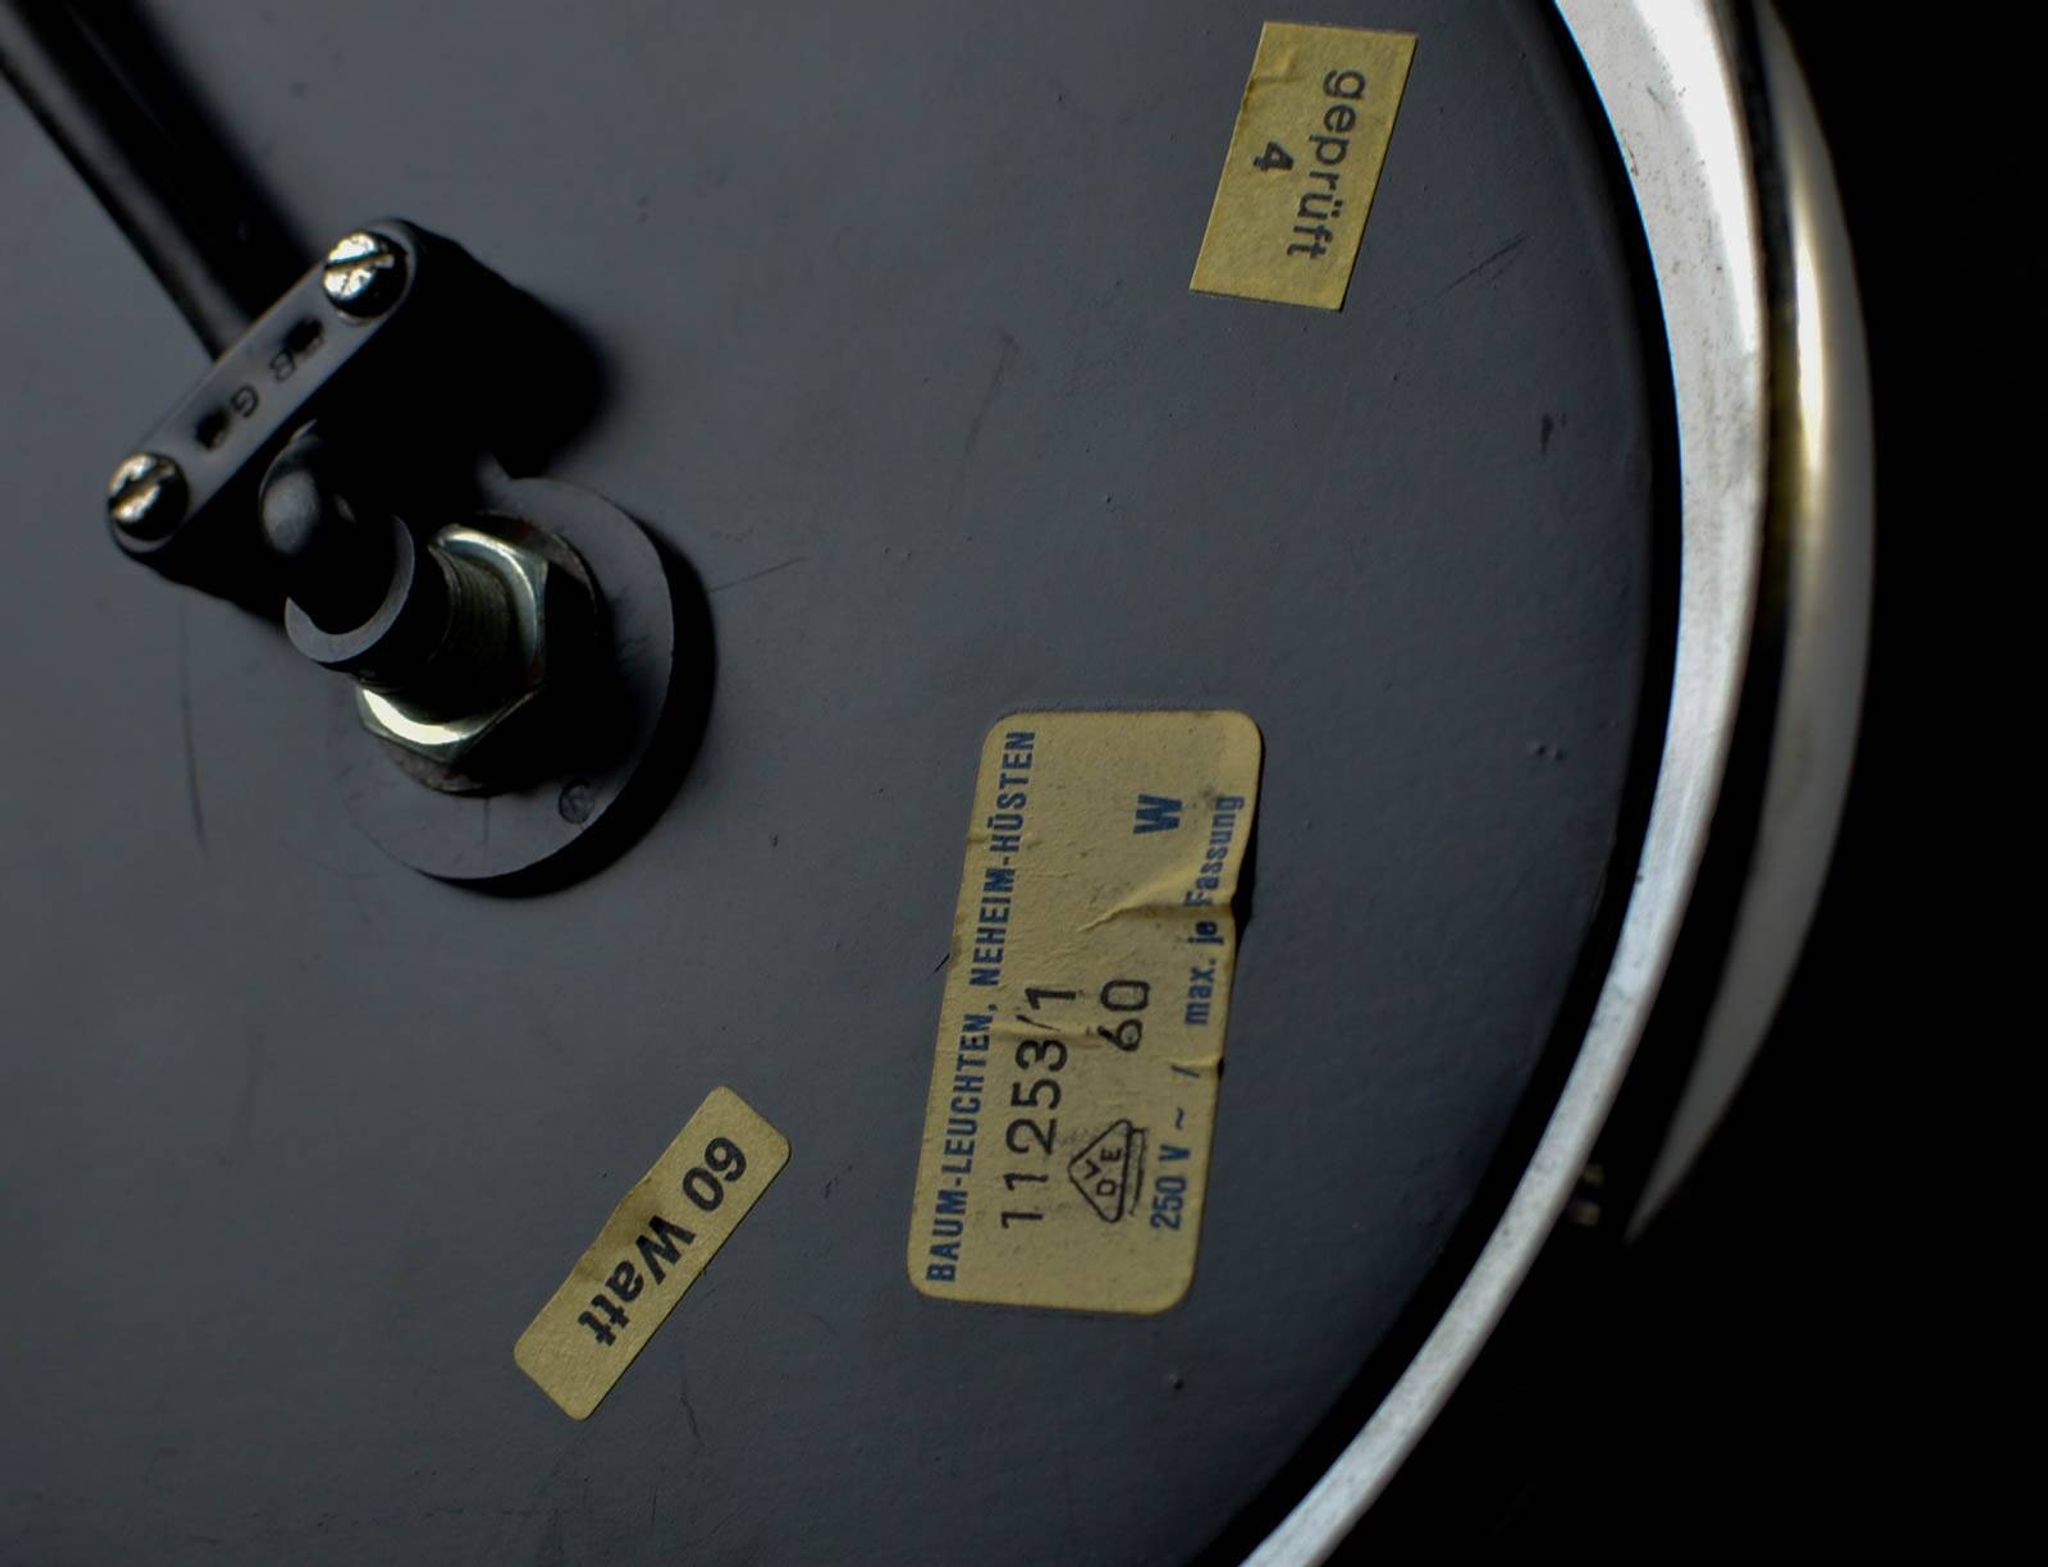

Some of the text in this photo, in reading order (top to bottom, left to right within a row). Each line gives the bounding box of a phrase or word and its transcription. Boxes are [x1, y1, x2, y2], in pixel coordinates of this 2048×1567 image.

[1253, 140, 1295, 172] 4
[1286, 69, 1366, 259] geprüft
[1183, 795, 1246, 908] Fassung
[1097, 793, 1184, 1051] 60 W
[1186, 920, 1226, 947] je
[925, 731, 1036, 1283] BAUM-LEUCHTEN, NEHEIM-HÜSTEN
[1184, 957, 1217, 1026] max.
[1001, 987, 1077, 1229] 11253/1
[1160, 1143, 1191, 1164] V
[577, 1136, 748, 1347] 60 Watt
[1150, 1175, 1188, 1231] 250
